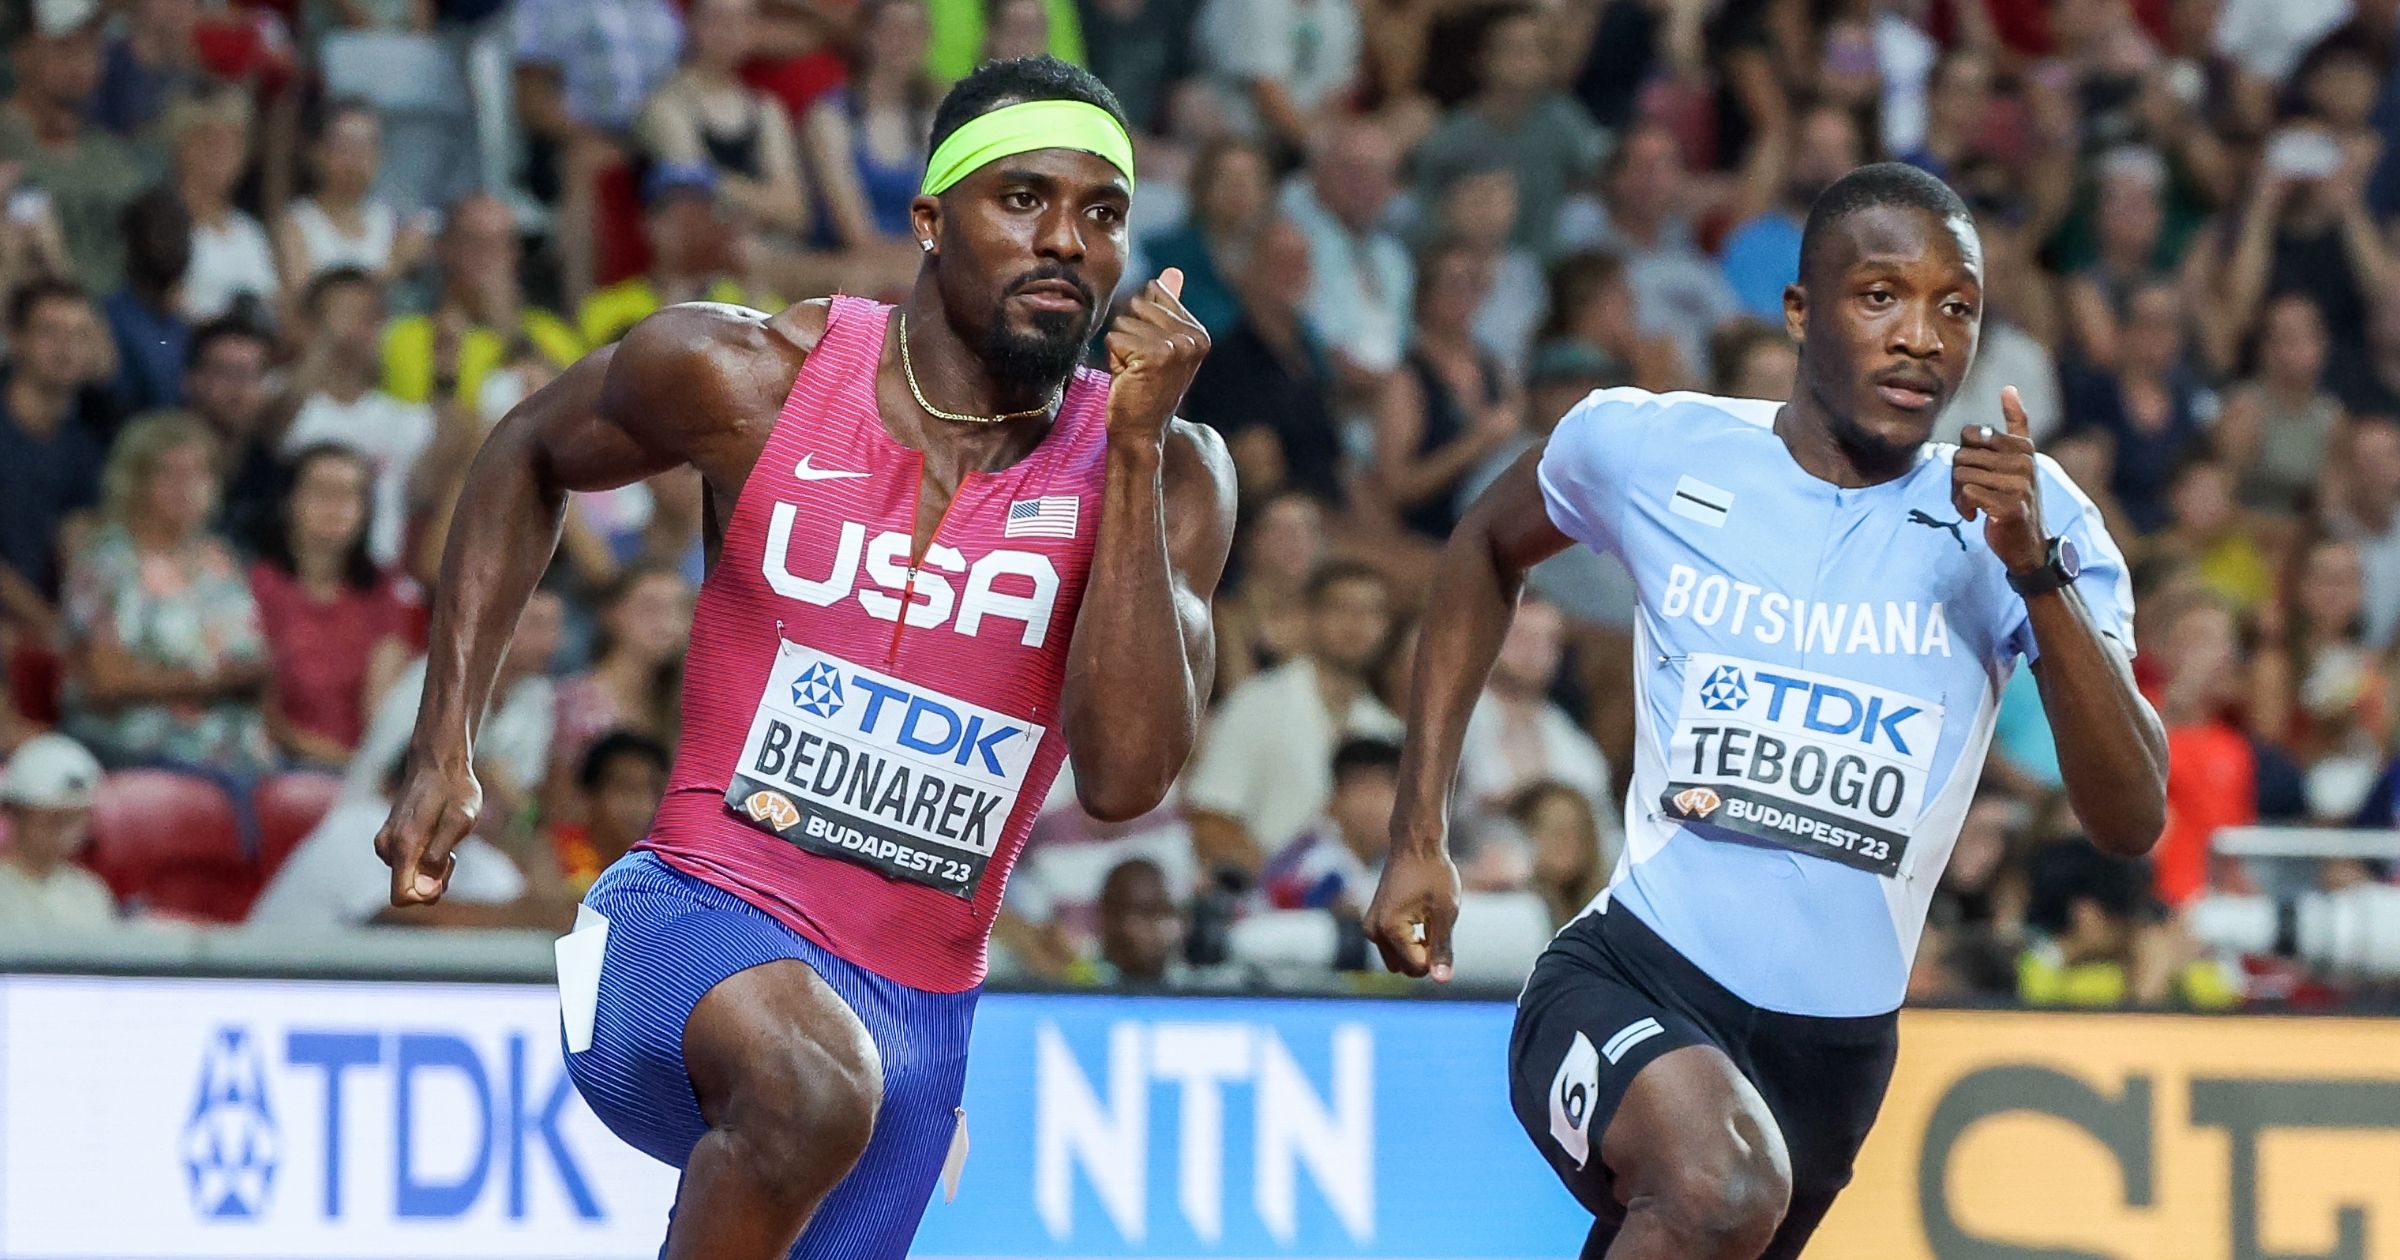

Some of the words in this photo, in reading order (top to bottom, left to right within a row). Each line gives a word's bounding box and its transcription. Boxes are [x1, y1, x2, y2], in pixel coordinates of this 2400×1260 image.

[762, 501, 1060, 648] USA
[1661, 563, 1952, 657] BOTSWANA
[852, 674, 1023, 778] TDK
[1754, 671, 1924, 756] TDK
[754, 719, 1002, 847] BEDNAREK
[1690, 727, 1905, 819] TEBOGO
[805, 816, 944, 875] BUDAPEST
[941, 860, 972, 883] 23
[1726, 798, 1862, 851] BUDAPEST
[1858, 836, 1890, 860] 23
[285, 1032, 607, 1223] TDK
[1034, 1021, 1375, 1243] NTN
[1561, 1071, 1587, 1131] 6
